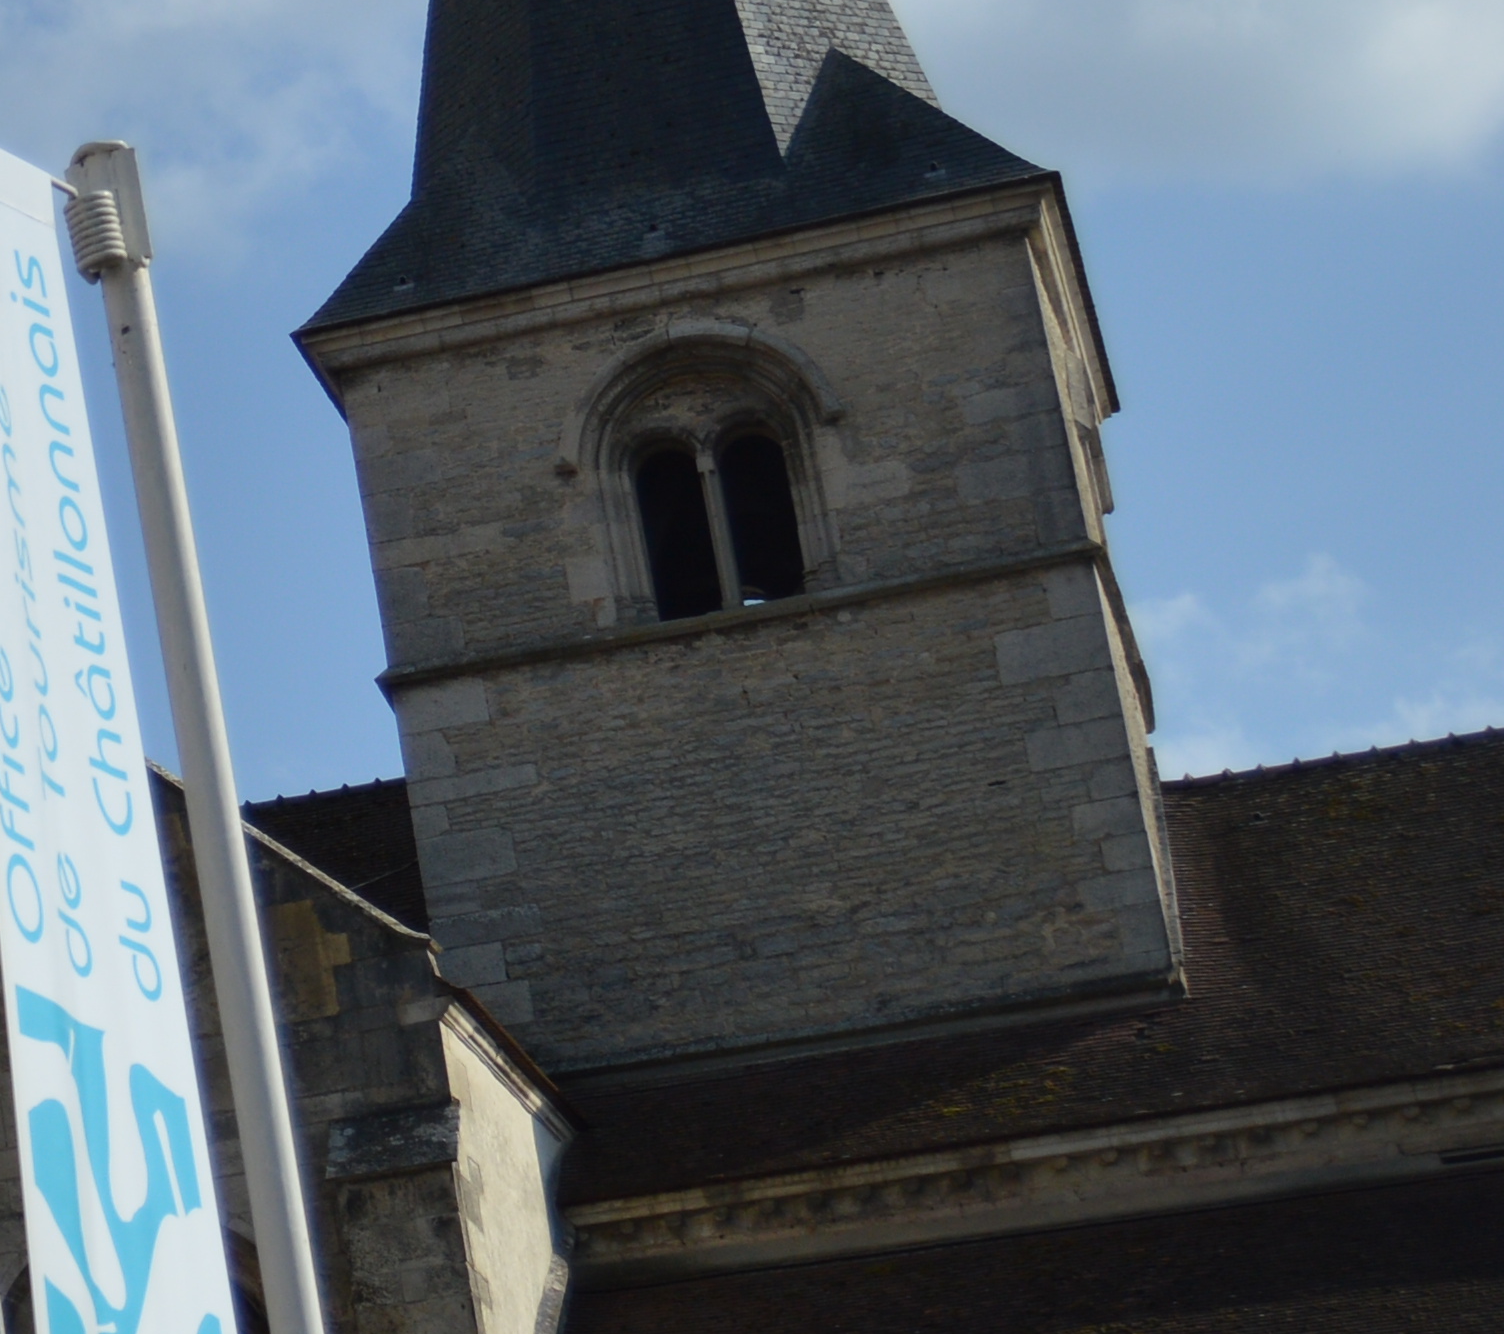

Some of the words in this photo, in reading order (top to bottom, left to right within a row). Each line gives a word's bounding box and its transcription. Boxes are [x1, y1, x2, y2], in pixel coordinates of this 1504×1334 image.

[9, 249, 133, 837] Châtillonnais
[58, 852, 93, 978] de
[119, 879, 162, 1002] du
